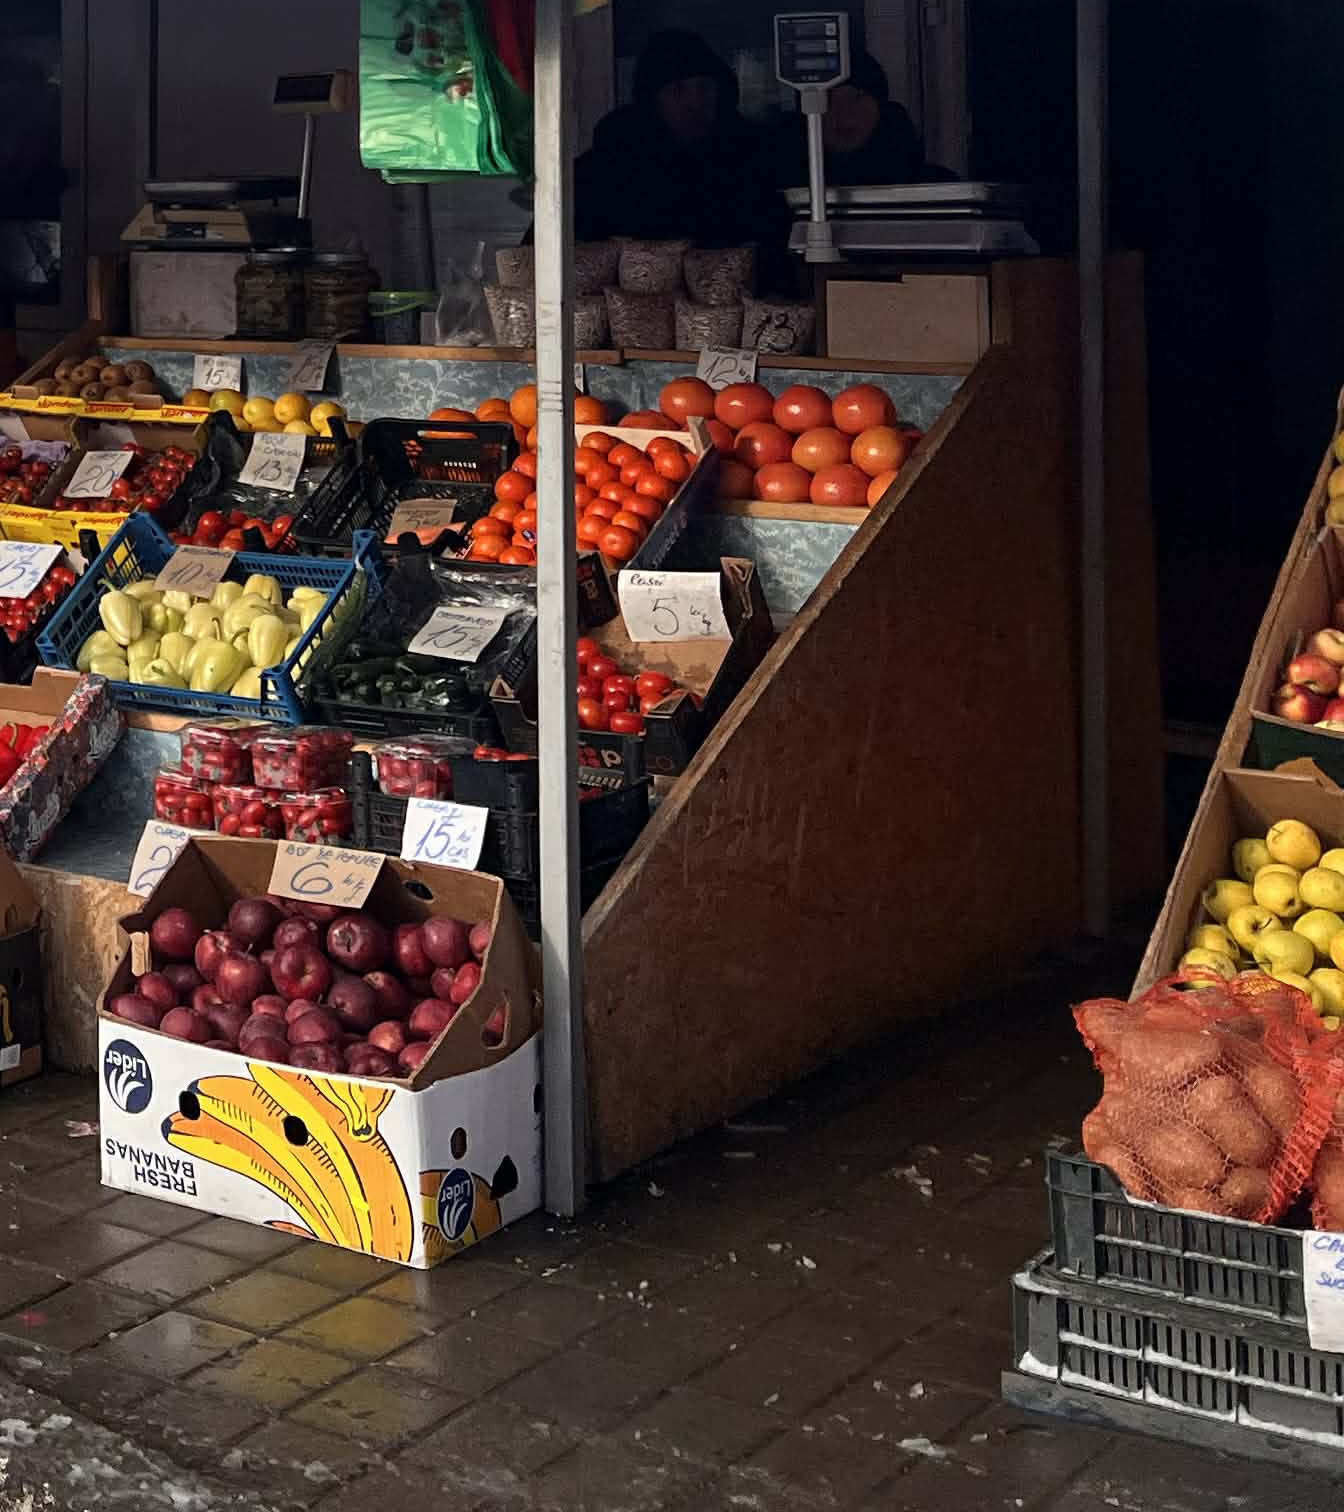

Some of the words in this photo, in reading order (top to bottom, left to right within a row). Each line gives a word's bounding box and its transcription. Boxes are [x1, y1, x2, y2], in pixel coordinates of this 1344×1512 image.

[652, 595, 680, 636] 5
[414, 819, 456, 859] 15
[290, 861, 333, 895] 6
[106, 1049, 147, 1080] Lider
[105, 1138, 195, 1179] BANANAS
[134, 1164, 198, 1197] FRESH
[440, 1179, 470, 1203] Lider
